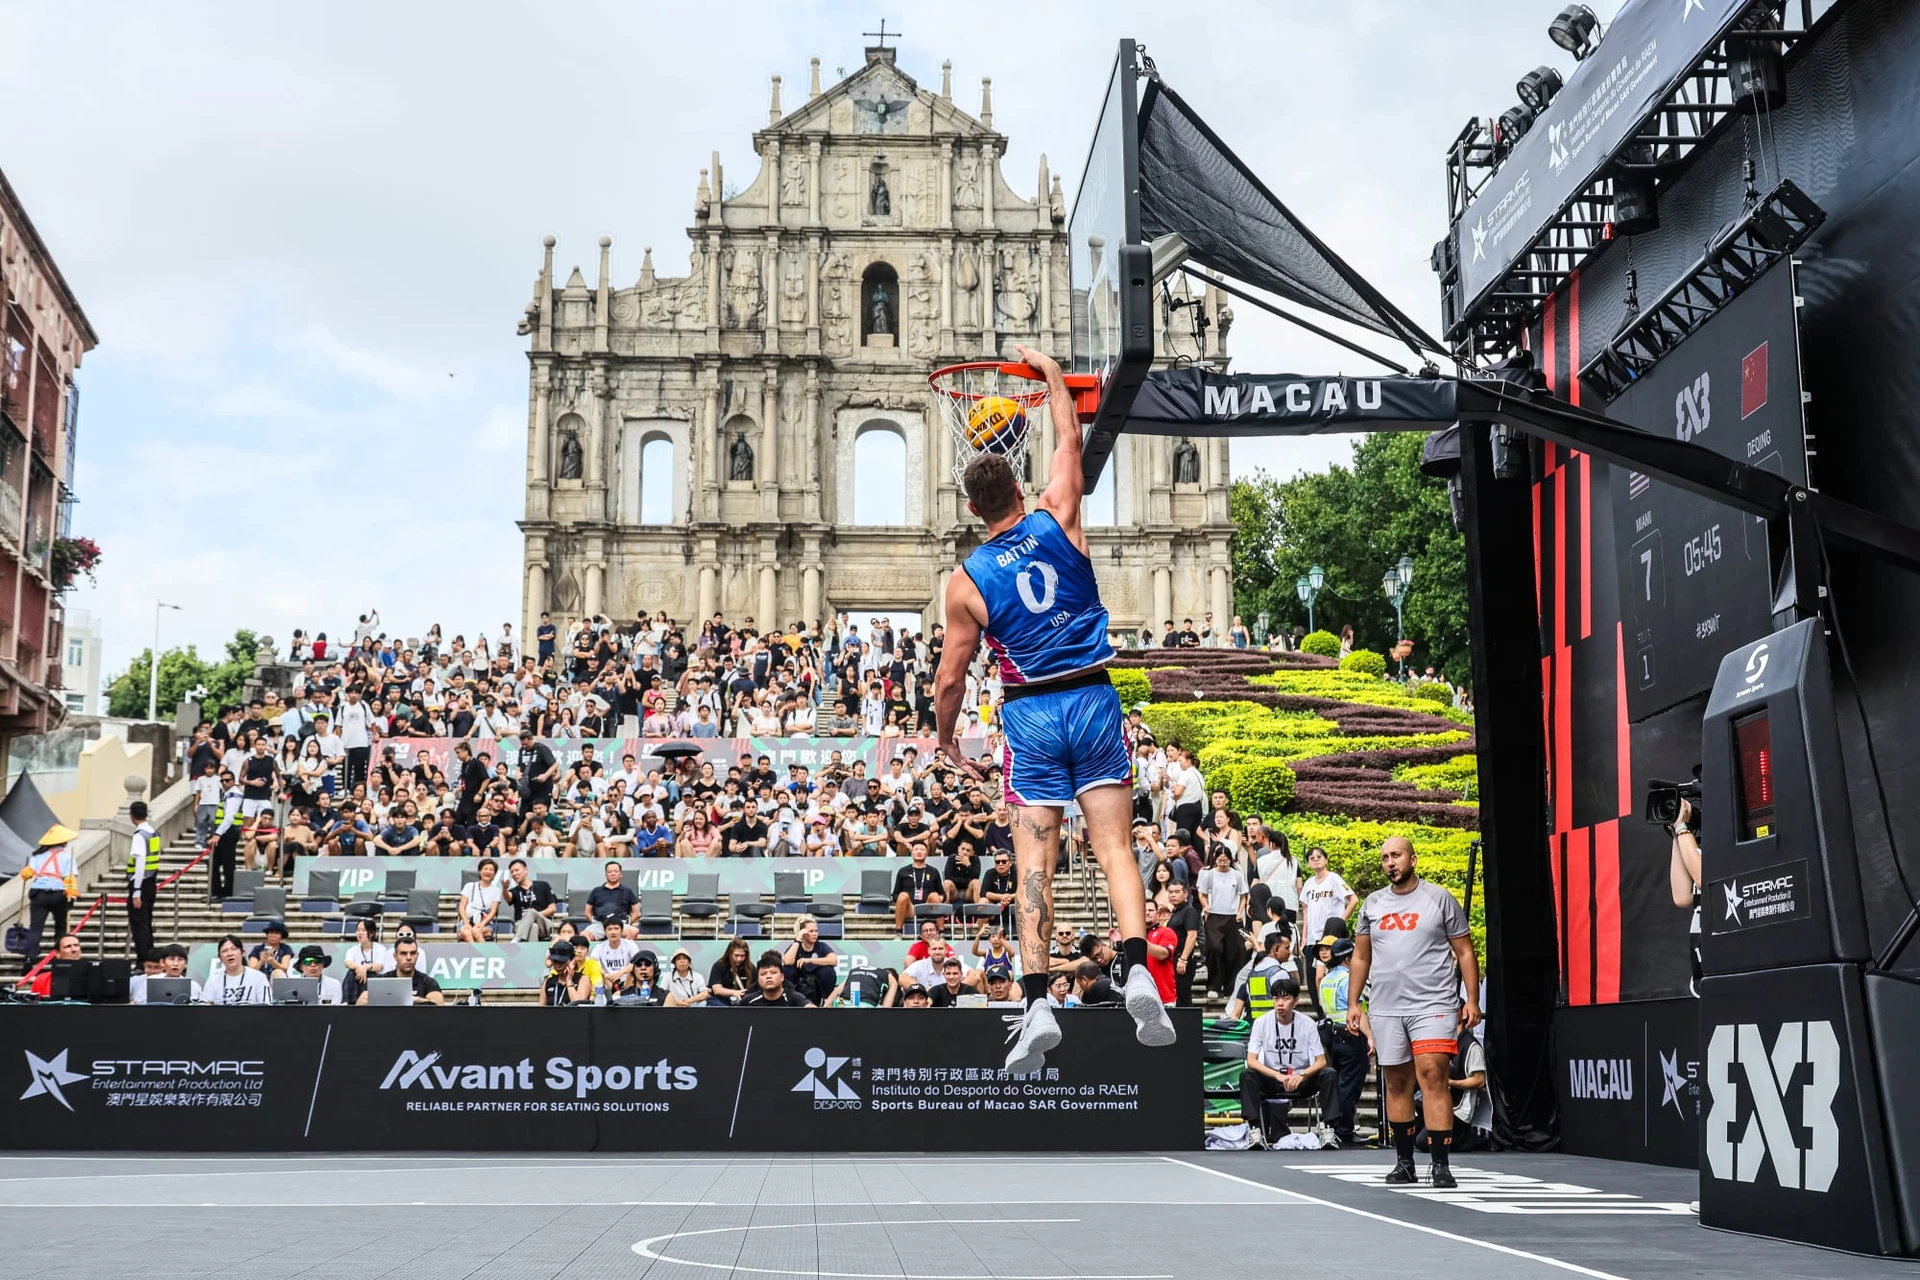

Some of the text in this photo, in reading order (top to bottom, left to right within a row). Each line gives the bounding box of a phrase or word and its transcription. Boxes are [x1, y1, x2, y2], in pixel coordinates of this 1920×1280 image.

[1204, 381, 1382, 415] MACAU
[1747, 429, 1771, 458] DEQING
[996, 533, 1039, 568] BATTIN
[1684, 524, 1722, 576] 05:45
[1016, 561, 1059, 614] 0
[1640, 549, 1652, 601] 7
[1049, 610, 1071, 628] USA
[638, 870, 674, 887] VIP
[1743, 875, 1793, 898] STARMAC
[92, 1060, 264, 1076] STARMAC
[379, 1050, 698, 1098] Avant Sports
[1569, 1059, 1633, 1100] MACAU
[92, 1079, 264, 1090] Entertainment Production Ltd
[872, 1084, 1139, 1098] Instituto do Desporto do Governo da RAEM
[406, 1101, 670, 1112] RELIABLE PARTNER FOR SEATING SOLUTIONS
[871, 1100, 1138, 1112] Sports Bureau of Macao SAR Government
